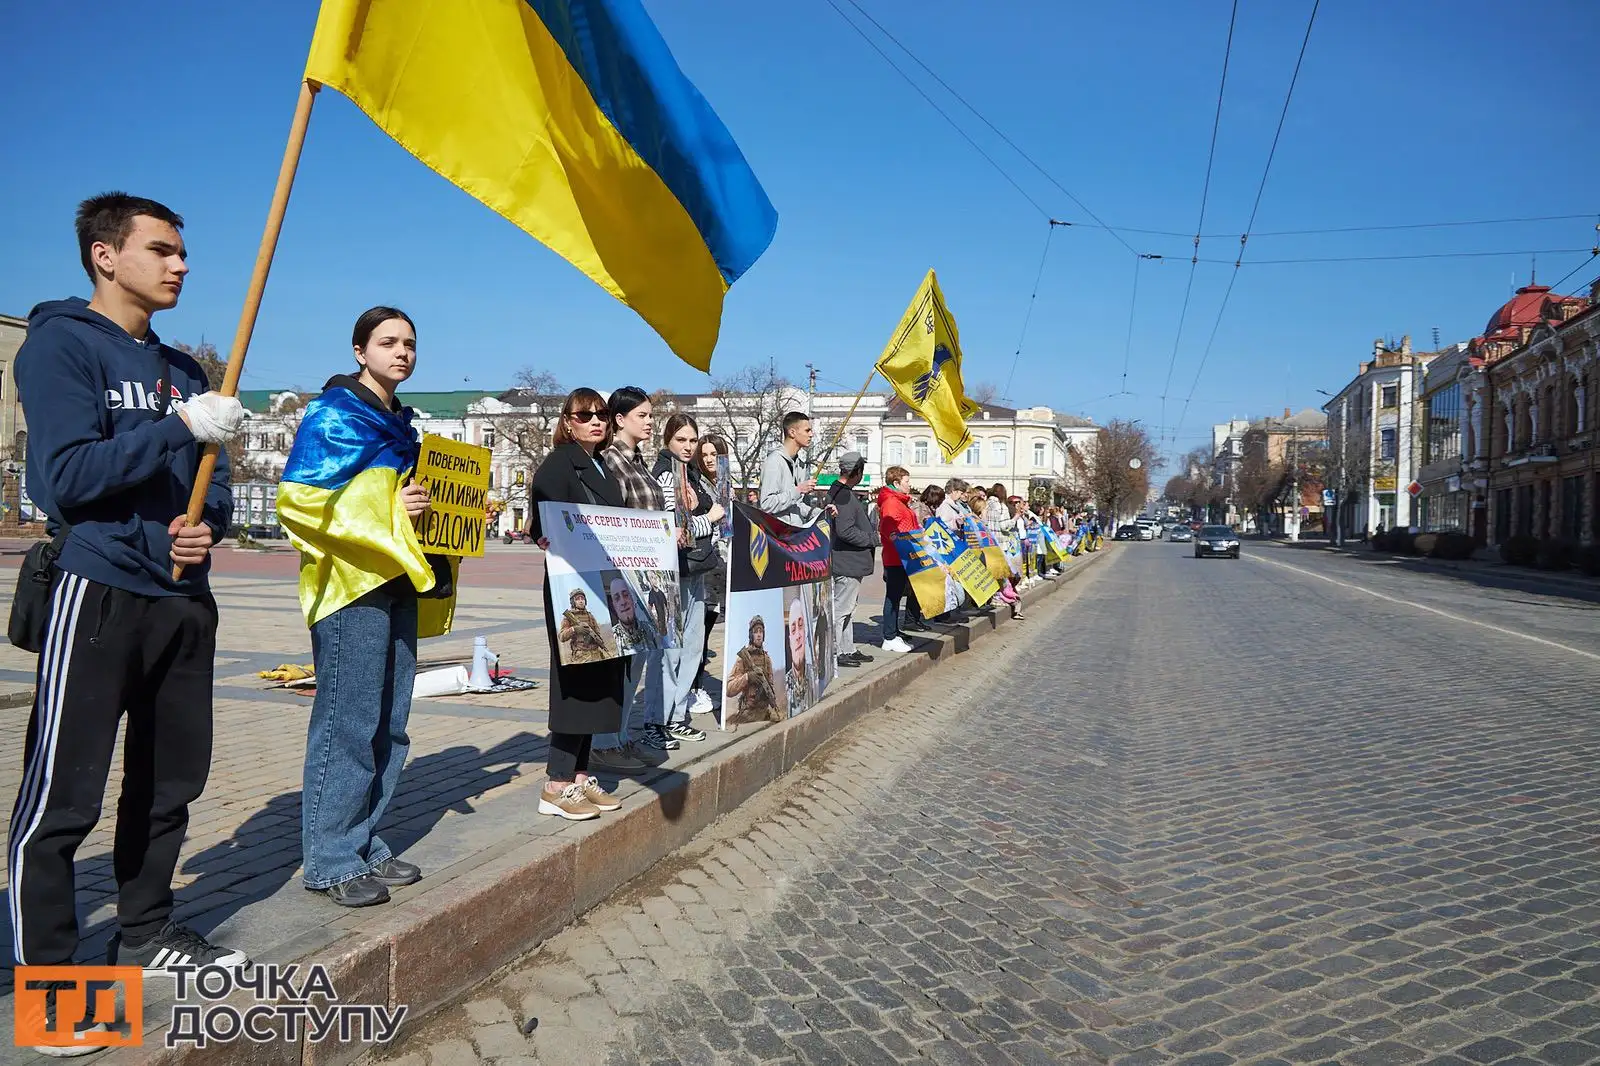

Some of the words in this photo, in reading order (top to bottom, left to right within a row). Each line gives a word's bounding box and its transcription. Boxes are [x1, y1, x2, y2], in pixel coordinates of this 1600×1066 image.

[427, 450, 481, 476] ПОВЕРНІТЬ
[414, 510, 483, 553] ДОДОМУ
[572, 513, 593, 524] МОЄ
[594, 515, 622, 528] СЕРЦЕ
[623, 517, 629, 528] У
